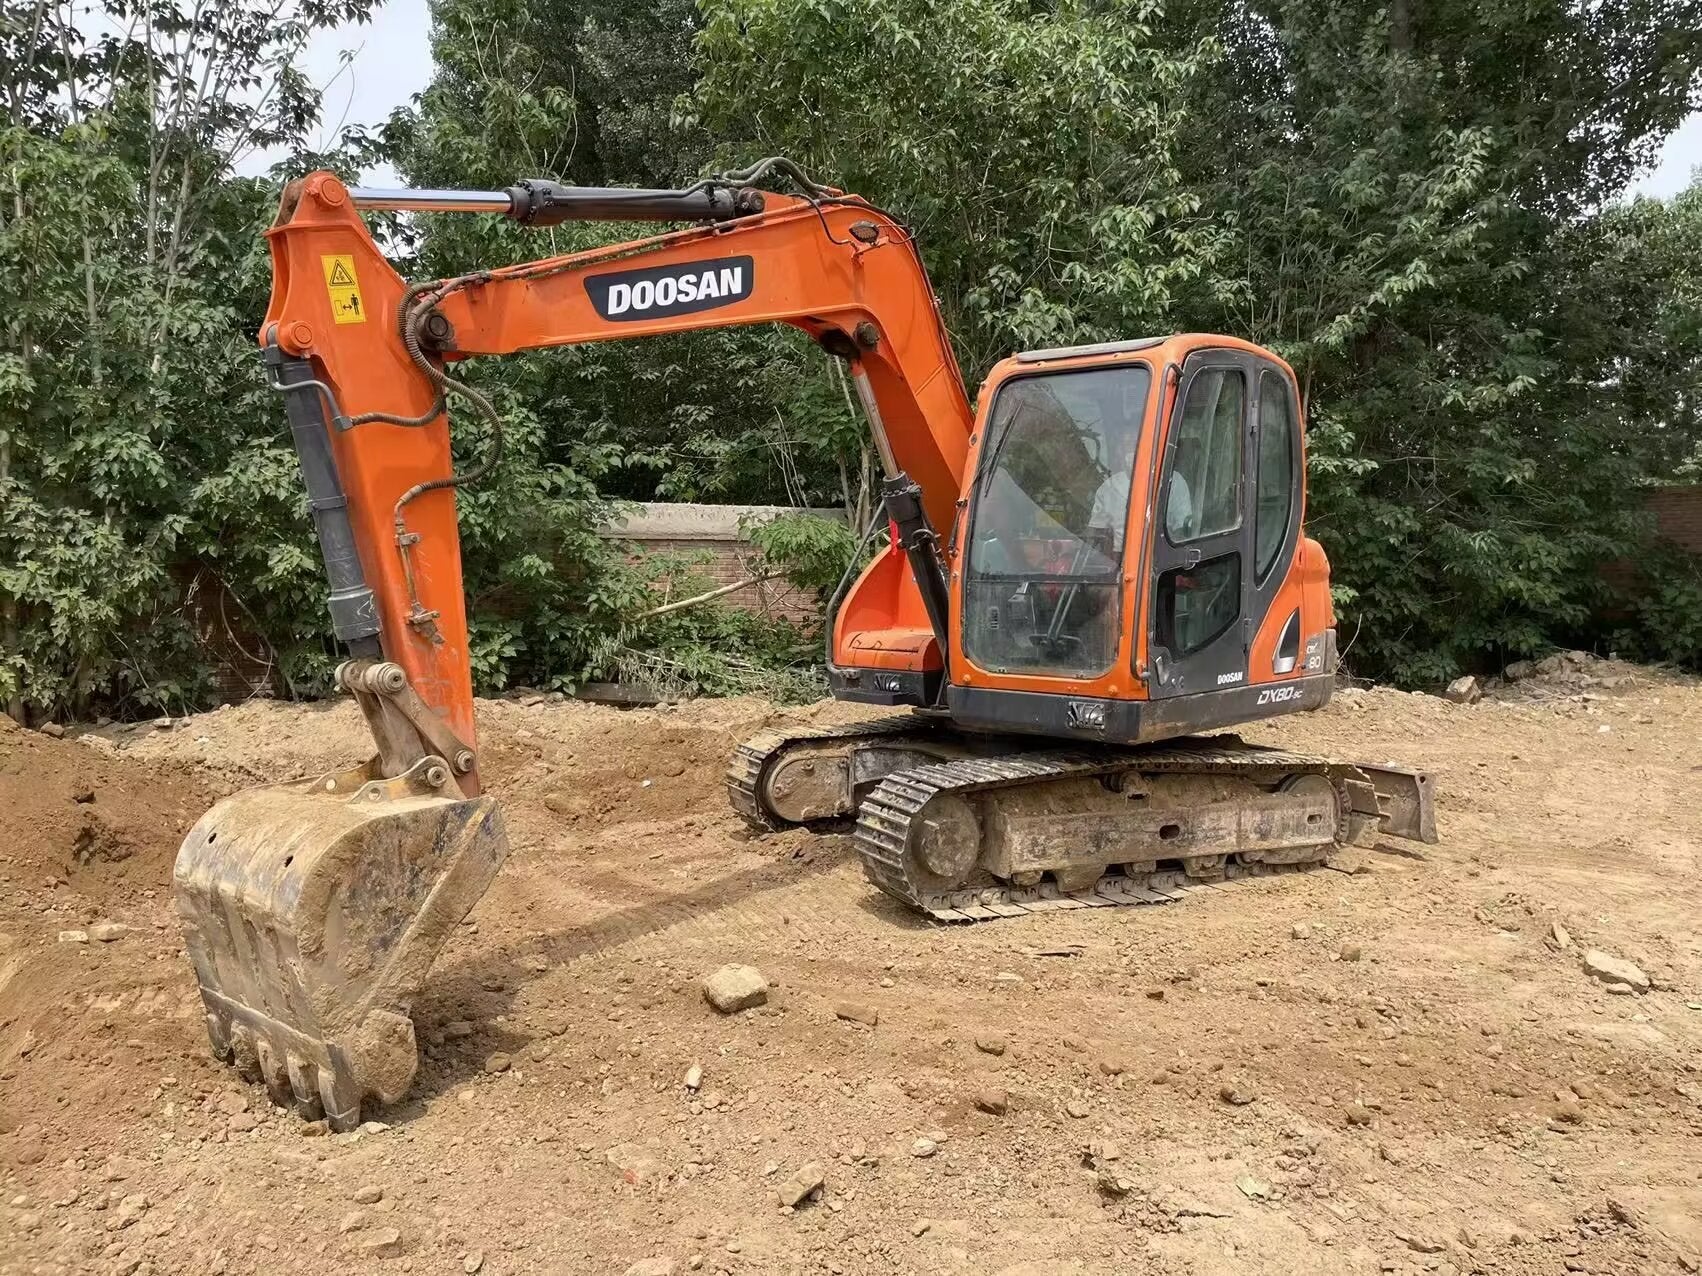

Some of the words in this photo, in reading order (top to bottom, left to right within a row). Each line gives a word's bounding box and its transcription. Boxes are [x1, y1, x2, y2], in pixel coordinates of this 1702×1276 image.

[607, 266, 742, 315] DOOSAN
[1309, 656, 1321, 669] 80
[1217, 671, 1243, 685] DOOSAN
